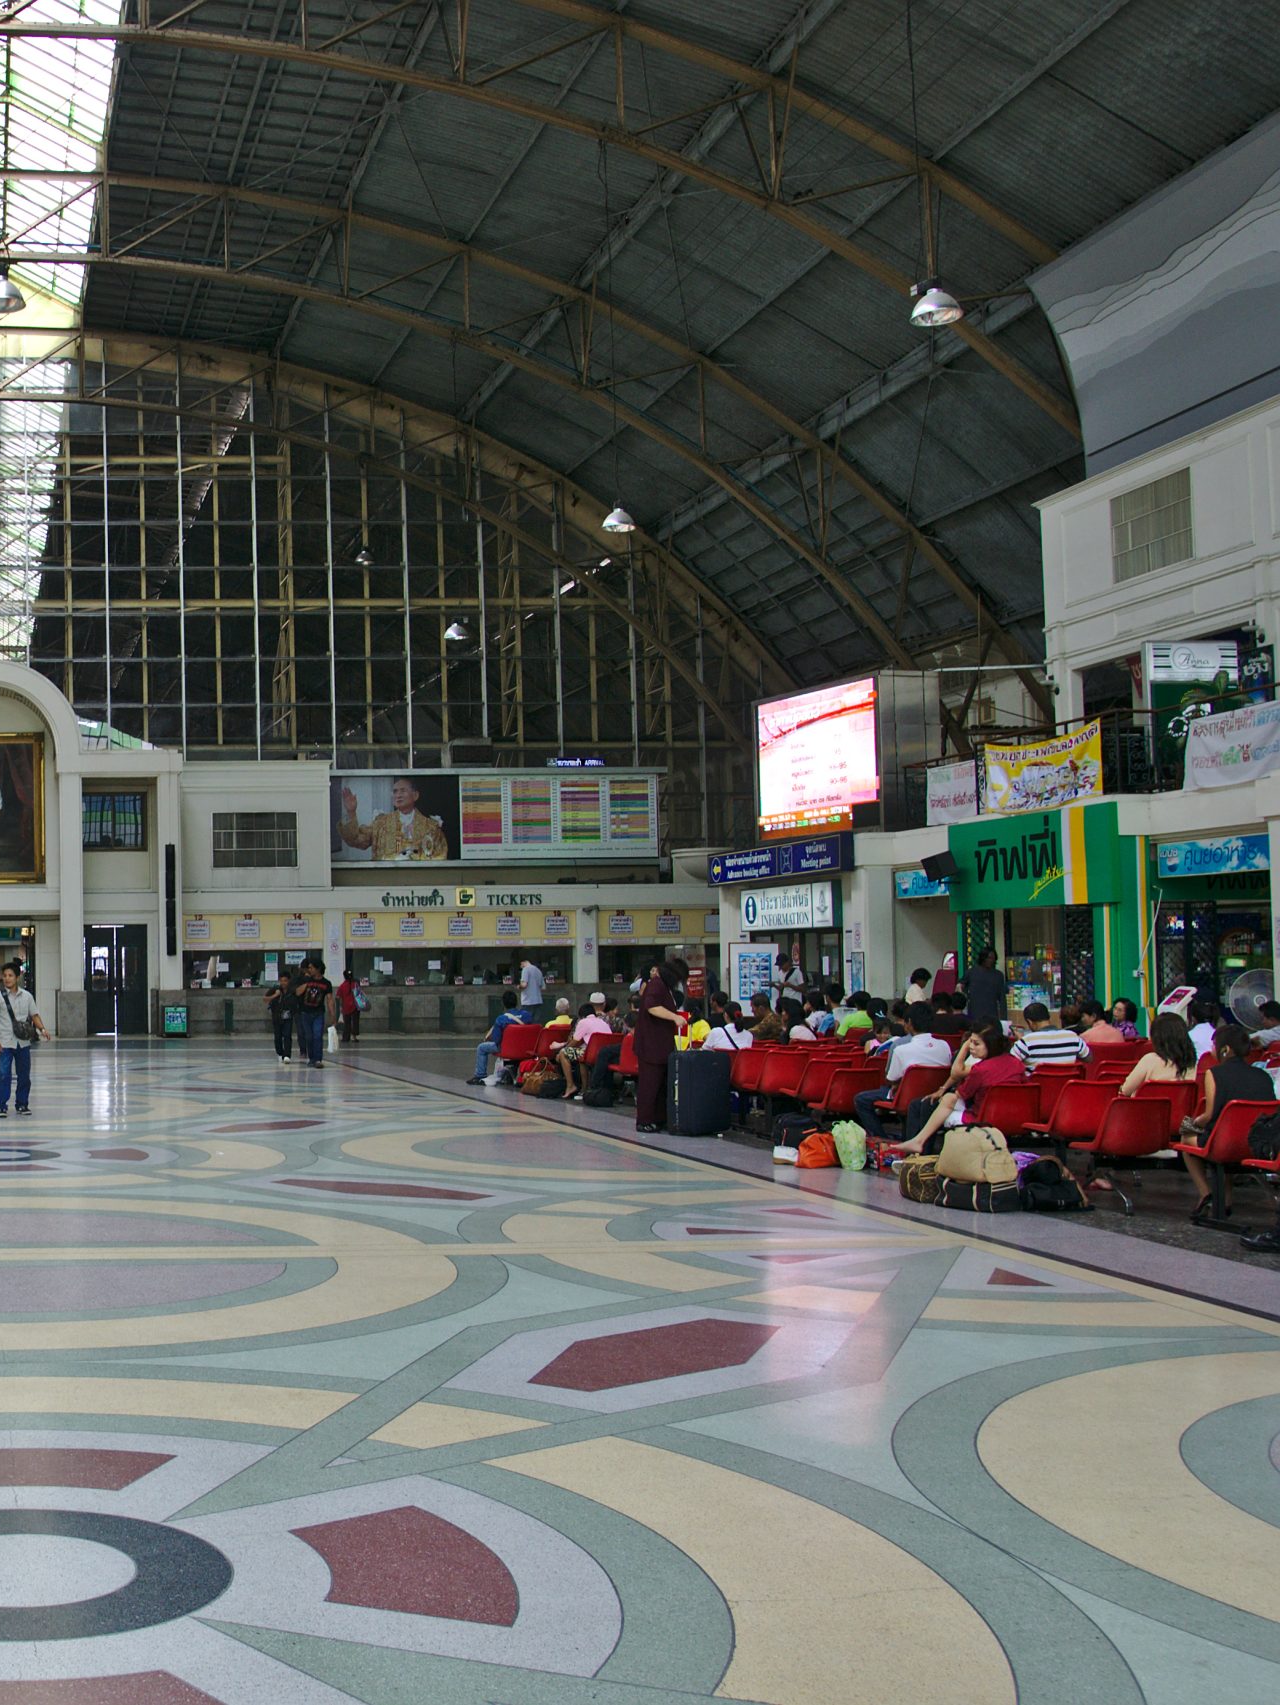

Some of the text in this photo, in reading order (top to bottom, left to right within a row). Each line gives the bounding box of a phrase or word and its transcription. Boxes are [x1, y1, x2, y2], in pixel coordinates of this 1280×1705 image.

[975, 815, 1058, 883] ทิฟฟี่
[1184, 843, 1260, 872] ศูนย์อาหาร
[381, 888, 445, 907] จำหน่ายตั๋ว
[486, 893, 542, 906] TICKETS
[761, 912, 809, 927] INFORMATION
